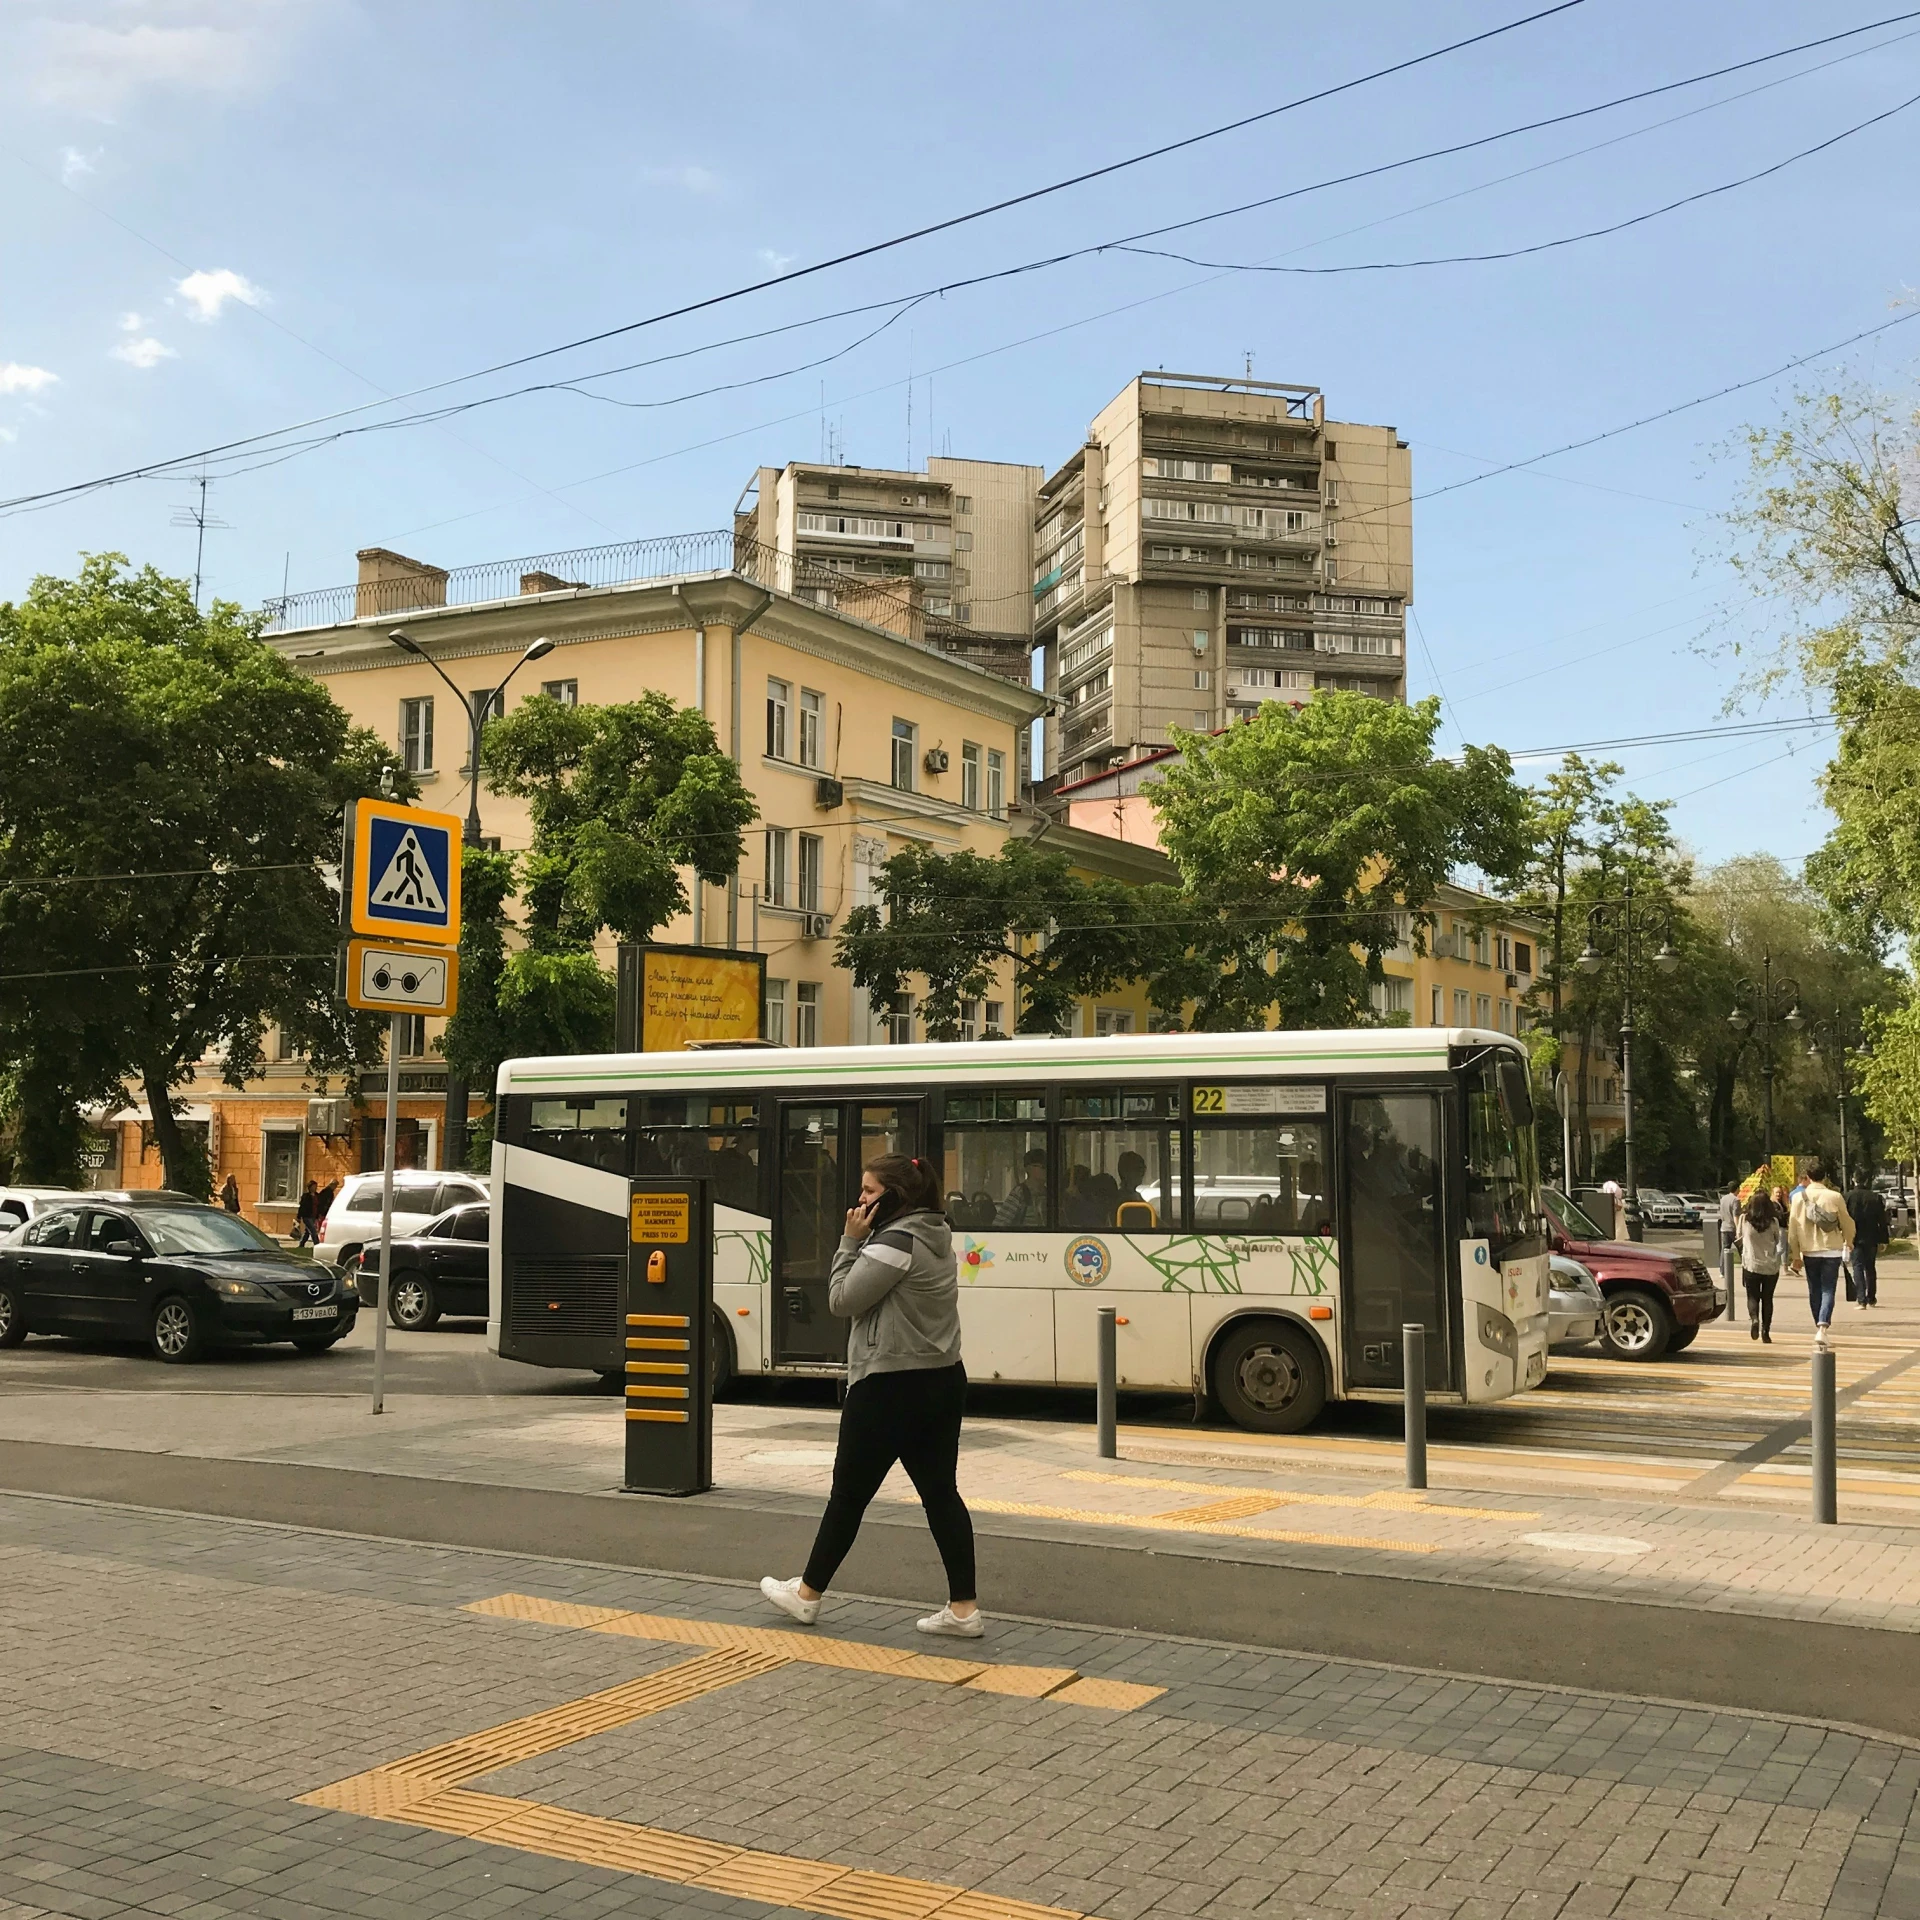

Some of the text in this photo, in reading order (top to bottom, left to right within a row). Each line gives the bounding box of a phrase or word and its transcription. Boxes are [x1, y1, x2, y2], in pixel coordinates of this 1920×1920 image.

[648, 1003, 663, 1017] The
[665, 1007, 677, 1021] city
[679, 1007, 688, 1022] of
[1195, 1089, 1223, 1111] 22
[1287, 1244, 1301, 1253] LE
[1508, 1267, 1522, 1276] ISUZU
[300, 1309, 313, 1318] 139
[328, 1307, 336, 1316] 02
